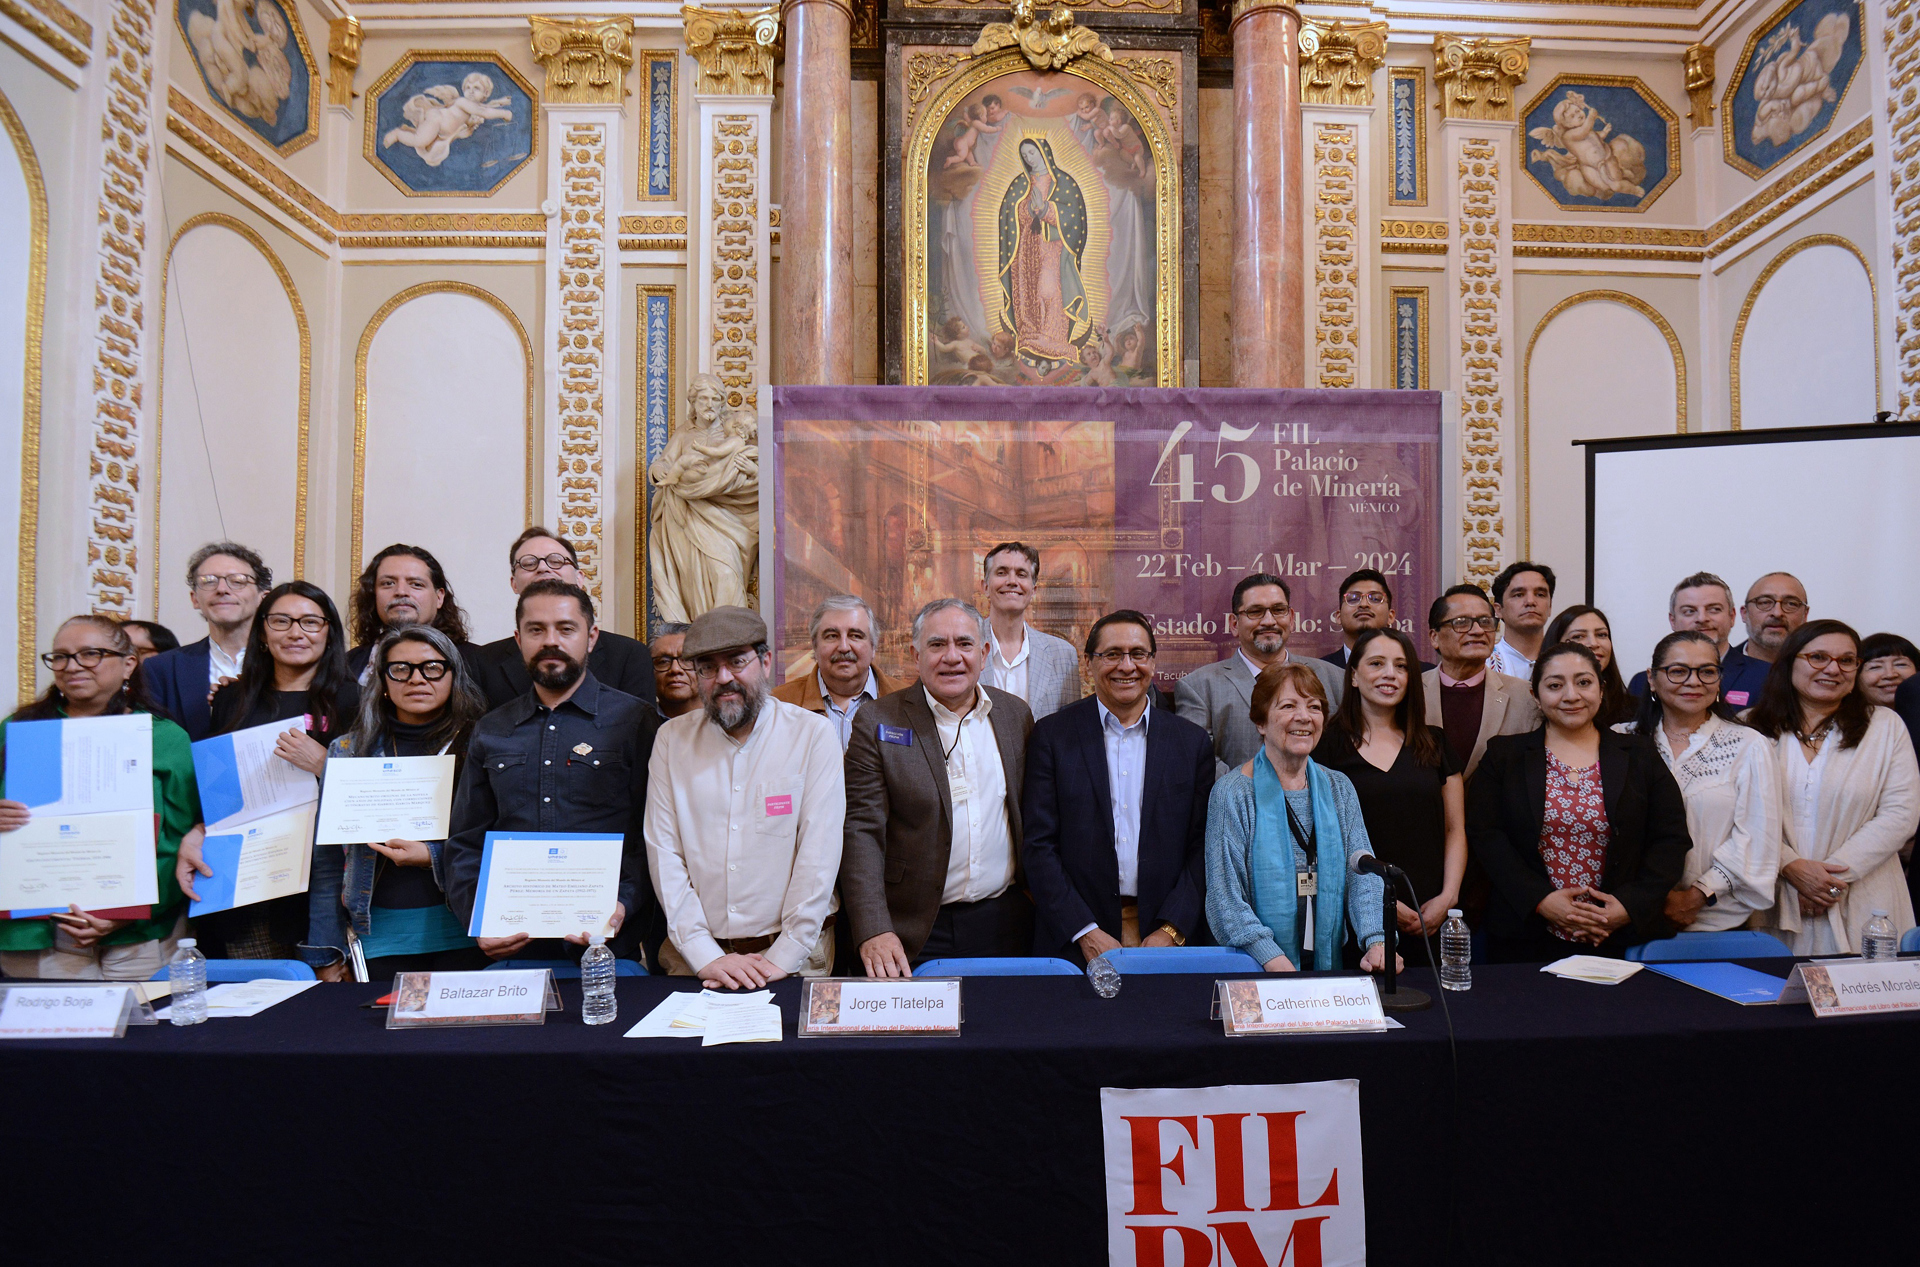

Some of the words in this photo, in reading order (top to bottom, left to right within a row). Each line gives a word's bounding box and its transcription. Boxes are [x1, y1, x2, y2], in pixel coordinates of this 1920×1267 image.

[1272, 422, 1320, 445] FIL
[1150, 420, 1261, 504] 45
[1273, 448, 1359, 472] Palacio
[1273, 475, 1303, 497] de
[1308, 474, 1402, 497] Minería
[1349, 500, 1400, 514] MÉXICO
[1136, 553, 1167, 578] 22
[1174, 553, 1222, 577] Feb
[1250, 552, 1264, 575] 4
[1272, 552, 1322, 577] Mar
[1354, 551, 1413, 576] 2024
[440, 985, 495, 1000] Baltazar
[497, 984, 528, 998] Brito
[1841, 982, 1881, 995] Andrés
[16, 996, 60, 1010] Rodrigo
[63, 996, 93, 1010] Borja
[849, 997, 887, 1013] Jorge
[891, 996, 944, 1012] Tlatelpa
[1266, 996, 1330, 1011] Catherine
[1333, 993, 1371, 1008] Bloch
[820, 1024, 860, 1032] Internacional
[1246, 1021, 1285, 1029] Internacional
[1297, 1019, 1314, 1027] Libro
[1325, 1018, 1349, 1026] Palacio
[1120, 1111, 1340, 1216] FIL
